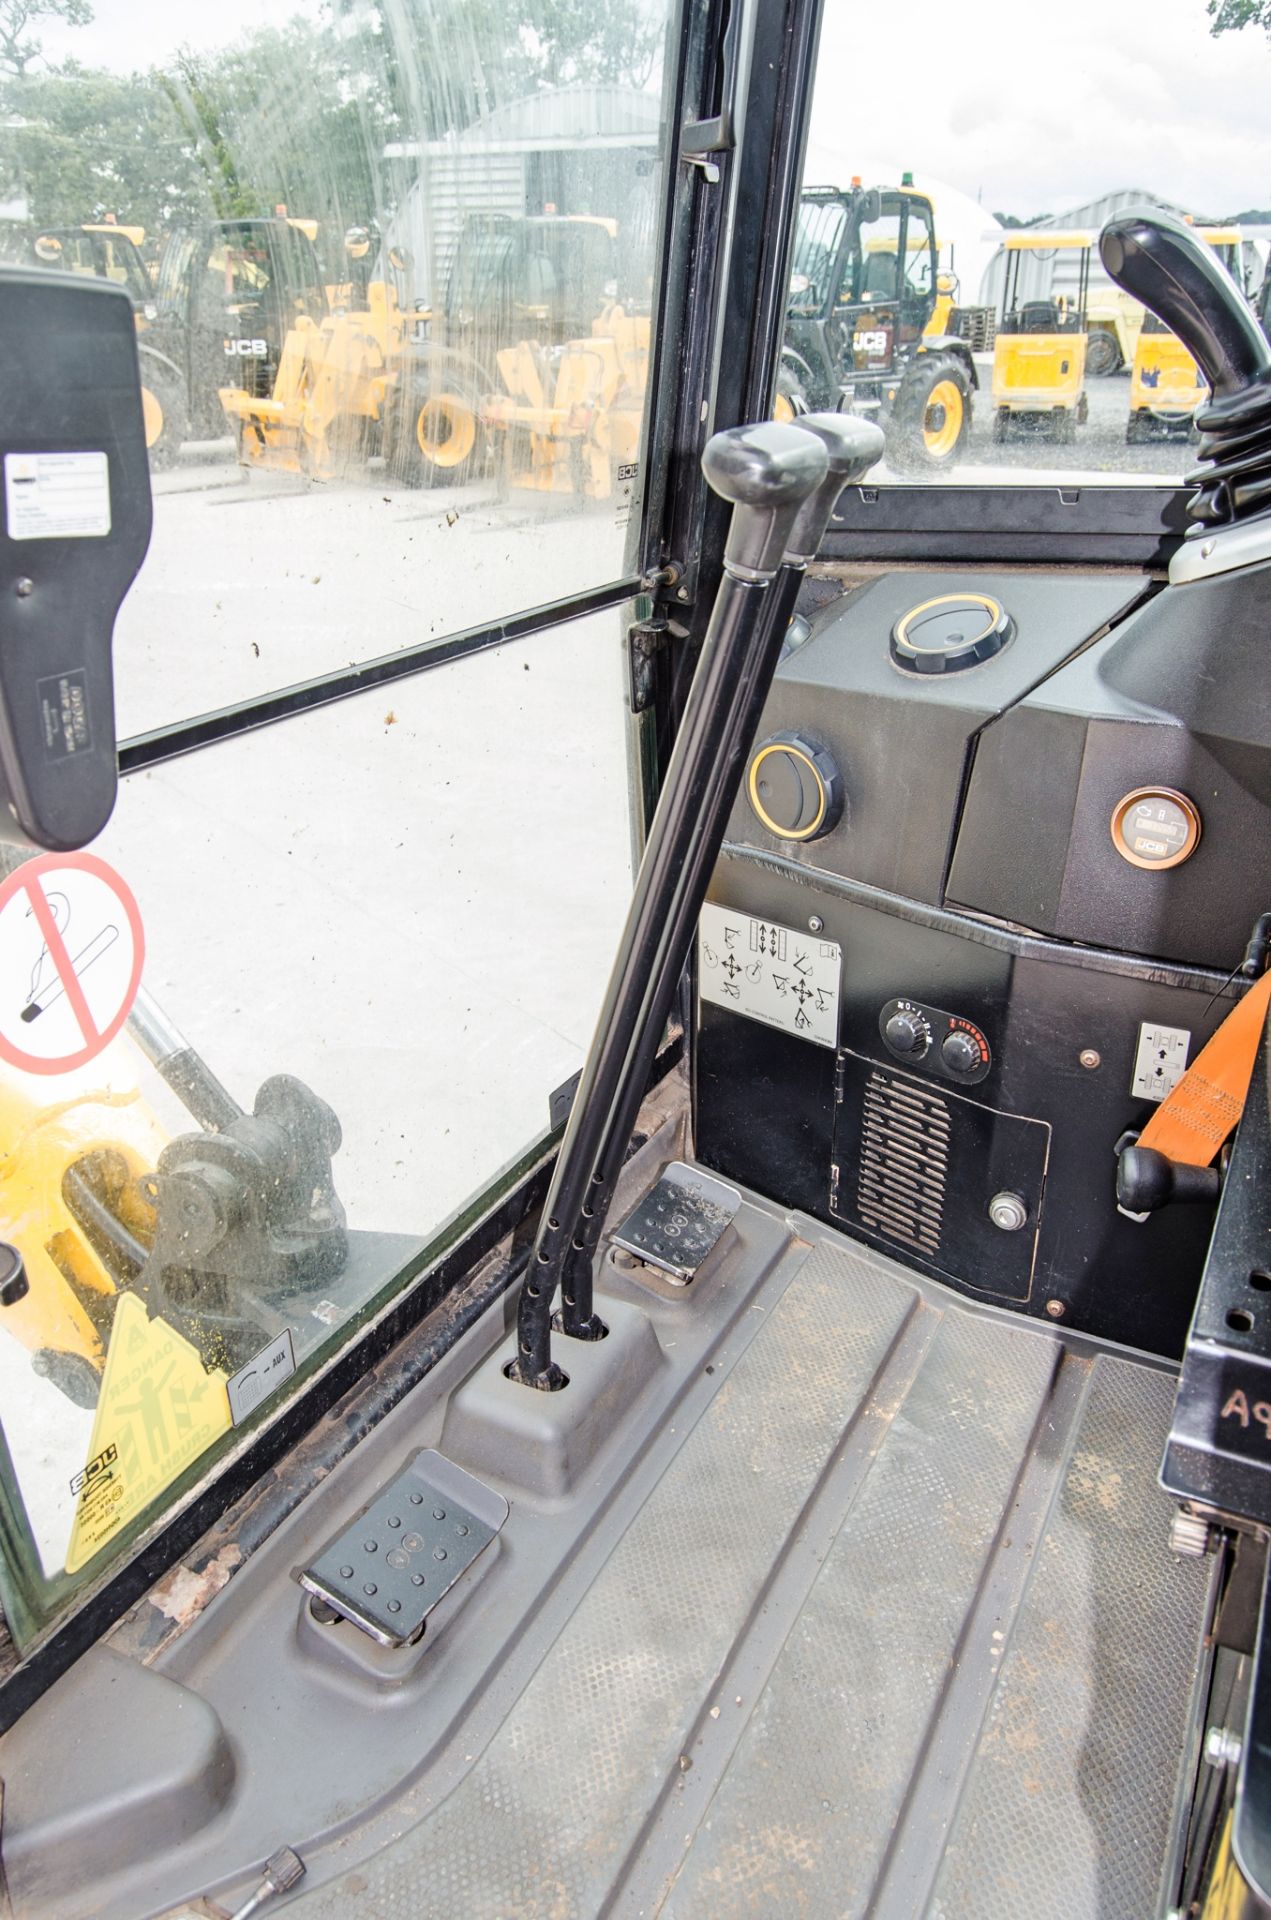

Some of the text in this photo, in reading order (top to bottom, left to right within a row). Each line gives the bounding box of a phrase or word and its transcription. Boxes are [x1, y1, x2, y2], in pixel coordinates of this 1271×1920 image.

[224, 339, 268, 355] JCB
[853, 332, 887, 351] JCB
[1136, 839, 1166, 854] JCB
[271, 1349, 286, 1369] AUX
